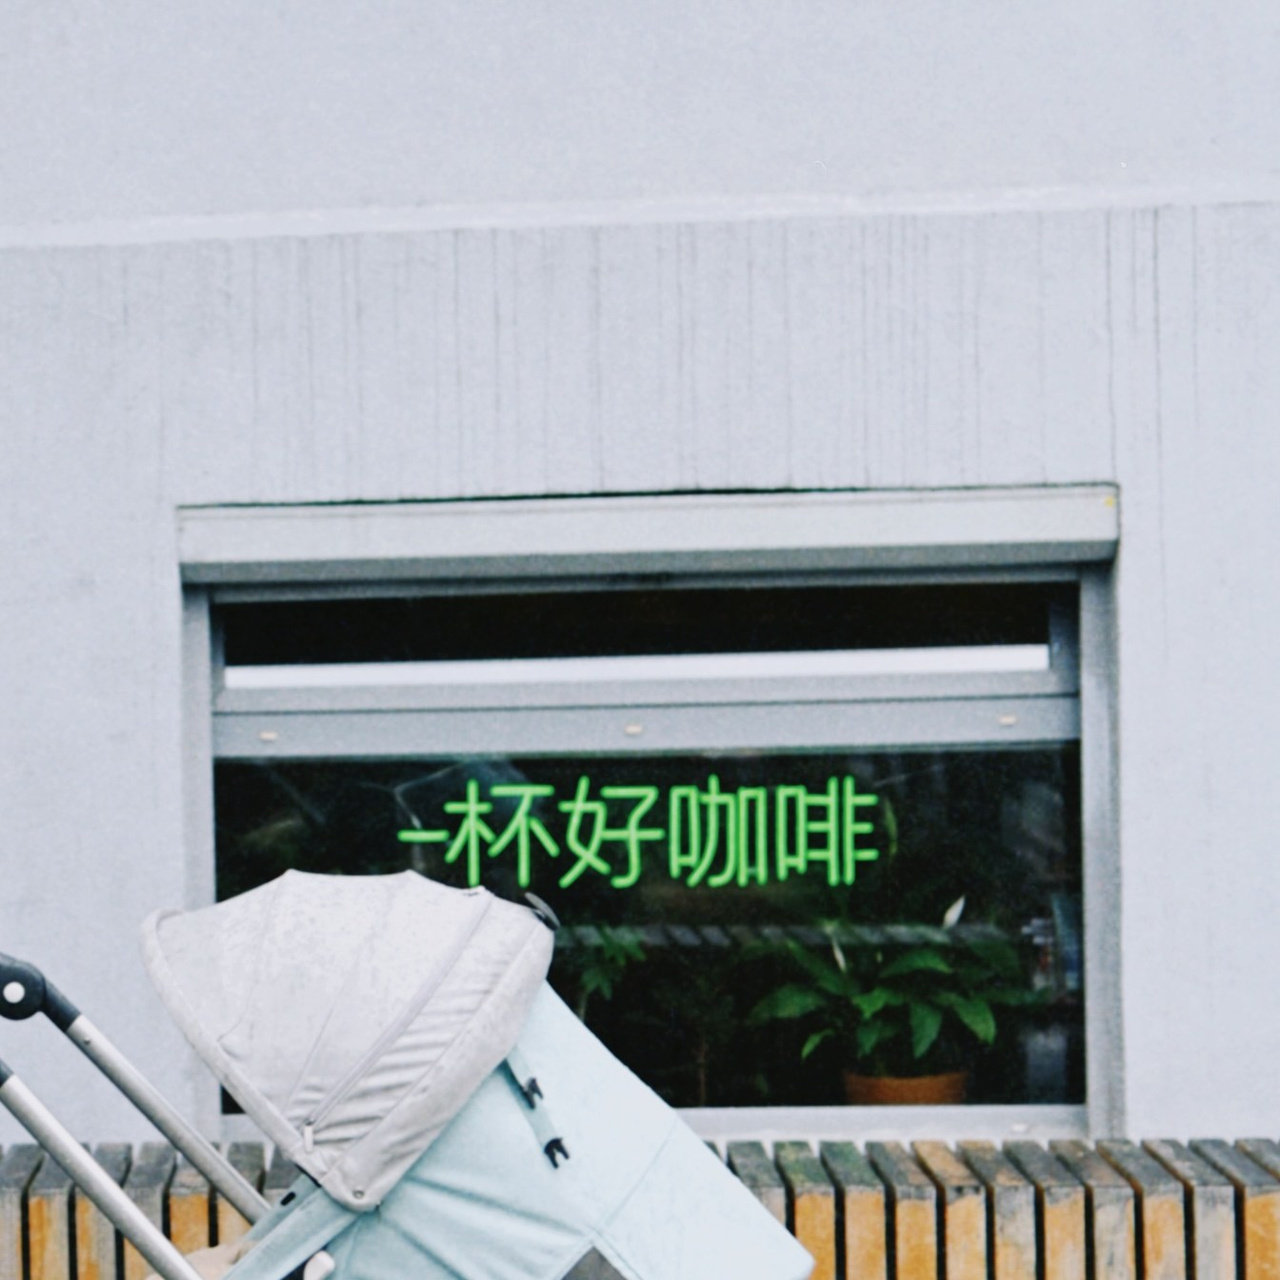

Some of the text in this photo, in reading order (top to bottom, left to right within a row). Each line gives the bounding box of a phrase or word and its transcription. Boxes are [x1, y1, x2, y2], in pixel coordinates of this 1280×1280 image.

[397, 774, 878, 888] 一杯好咖啡
